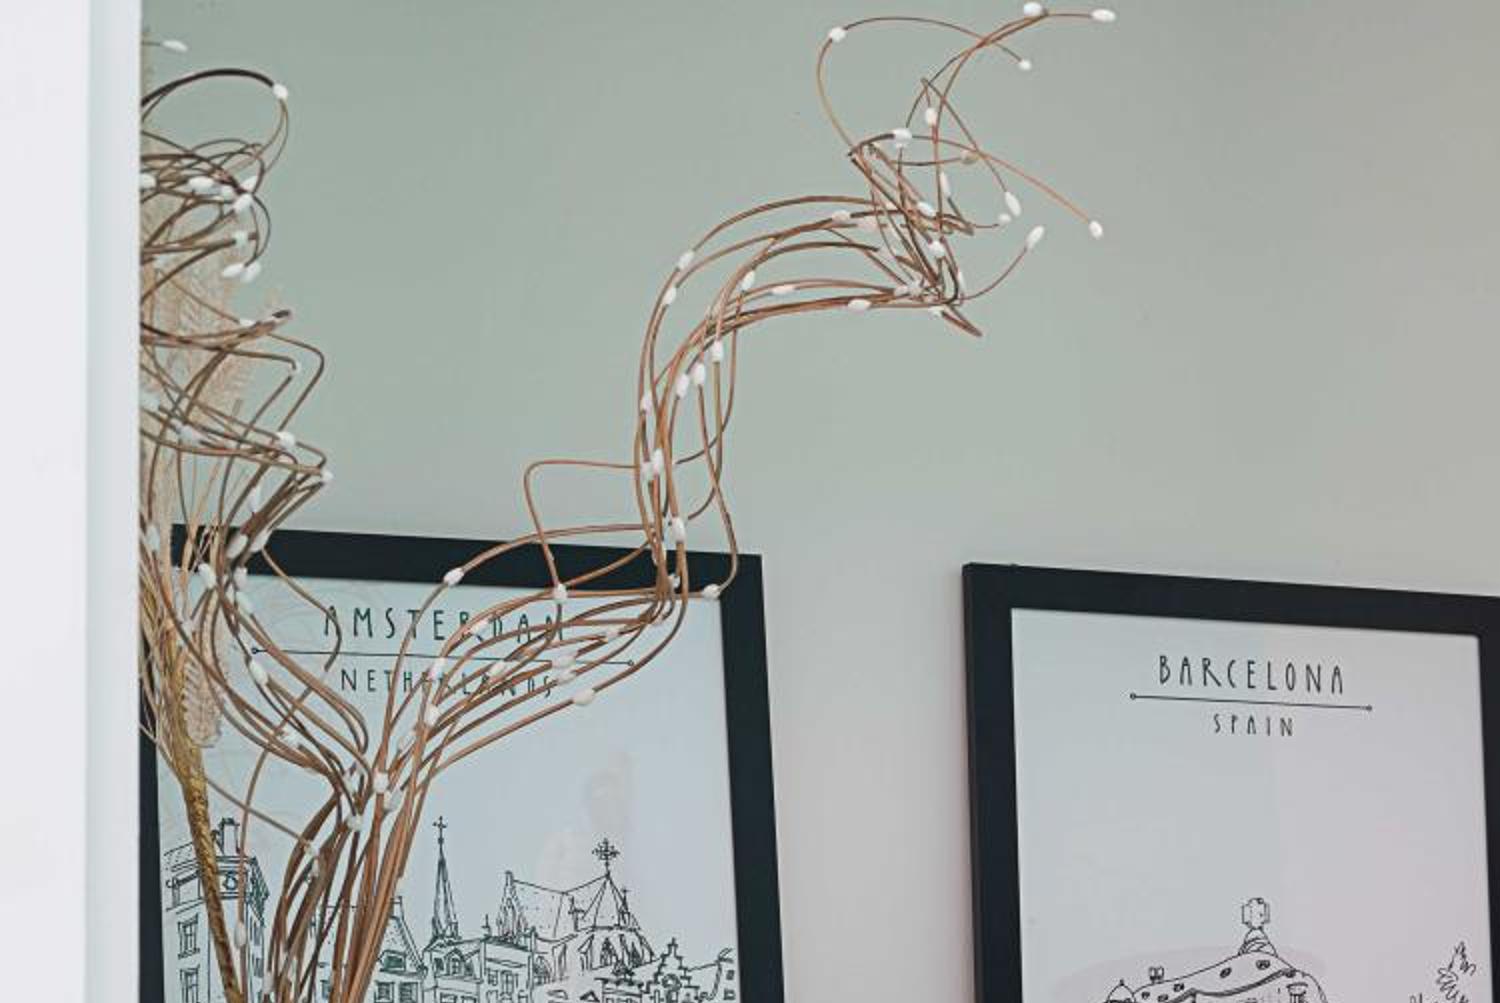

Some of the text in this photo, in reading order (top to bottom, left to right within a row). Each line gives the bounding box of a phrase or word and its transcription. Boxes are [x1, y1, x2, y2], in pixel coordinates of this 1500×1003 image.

[340, 668, 552, 698] NETHLDS
[1159, 654, 1344, 694] BARCELONA
[1213, 713, 1294, 737] SPAIN
